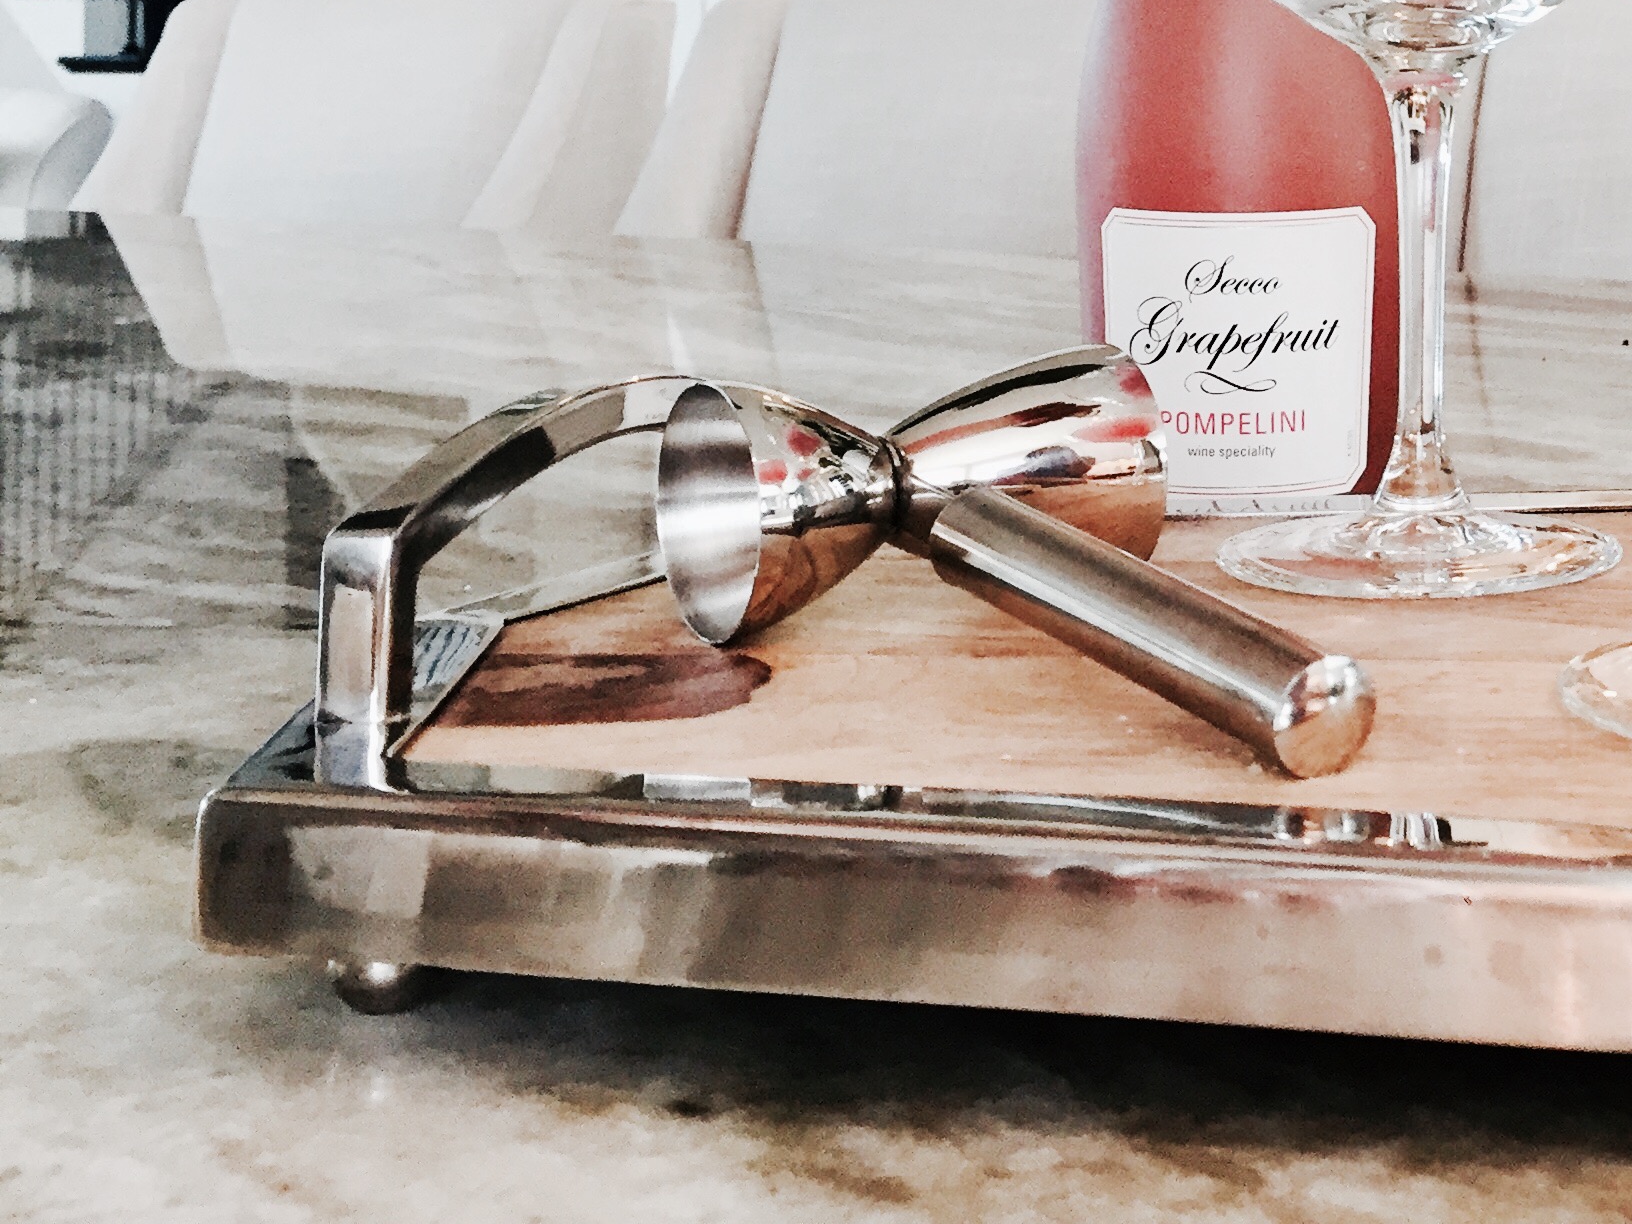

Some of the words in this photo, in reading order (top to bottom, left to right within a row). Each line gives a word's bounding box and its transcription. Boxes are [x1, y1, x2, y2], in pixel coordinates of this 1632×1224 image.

[1184, 255, 1283, 303] Secco
[1129, 296, 1341, 373] Grapefruit
[1160, 408, 1306, 435] POMPELINI
[1187, 447, 1216, 458] wine
[1218, 445, 1277, 460] speciality
